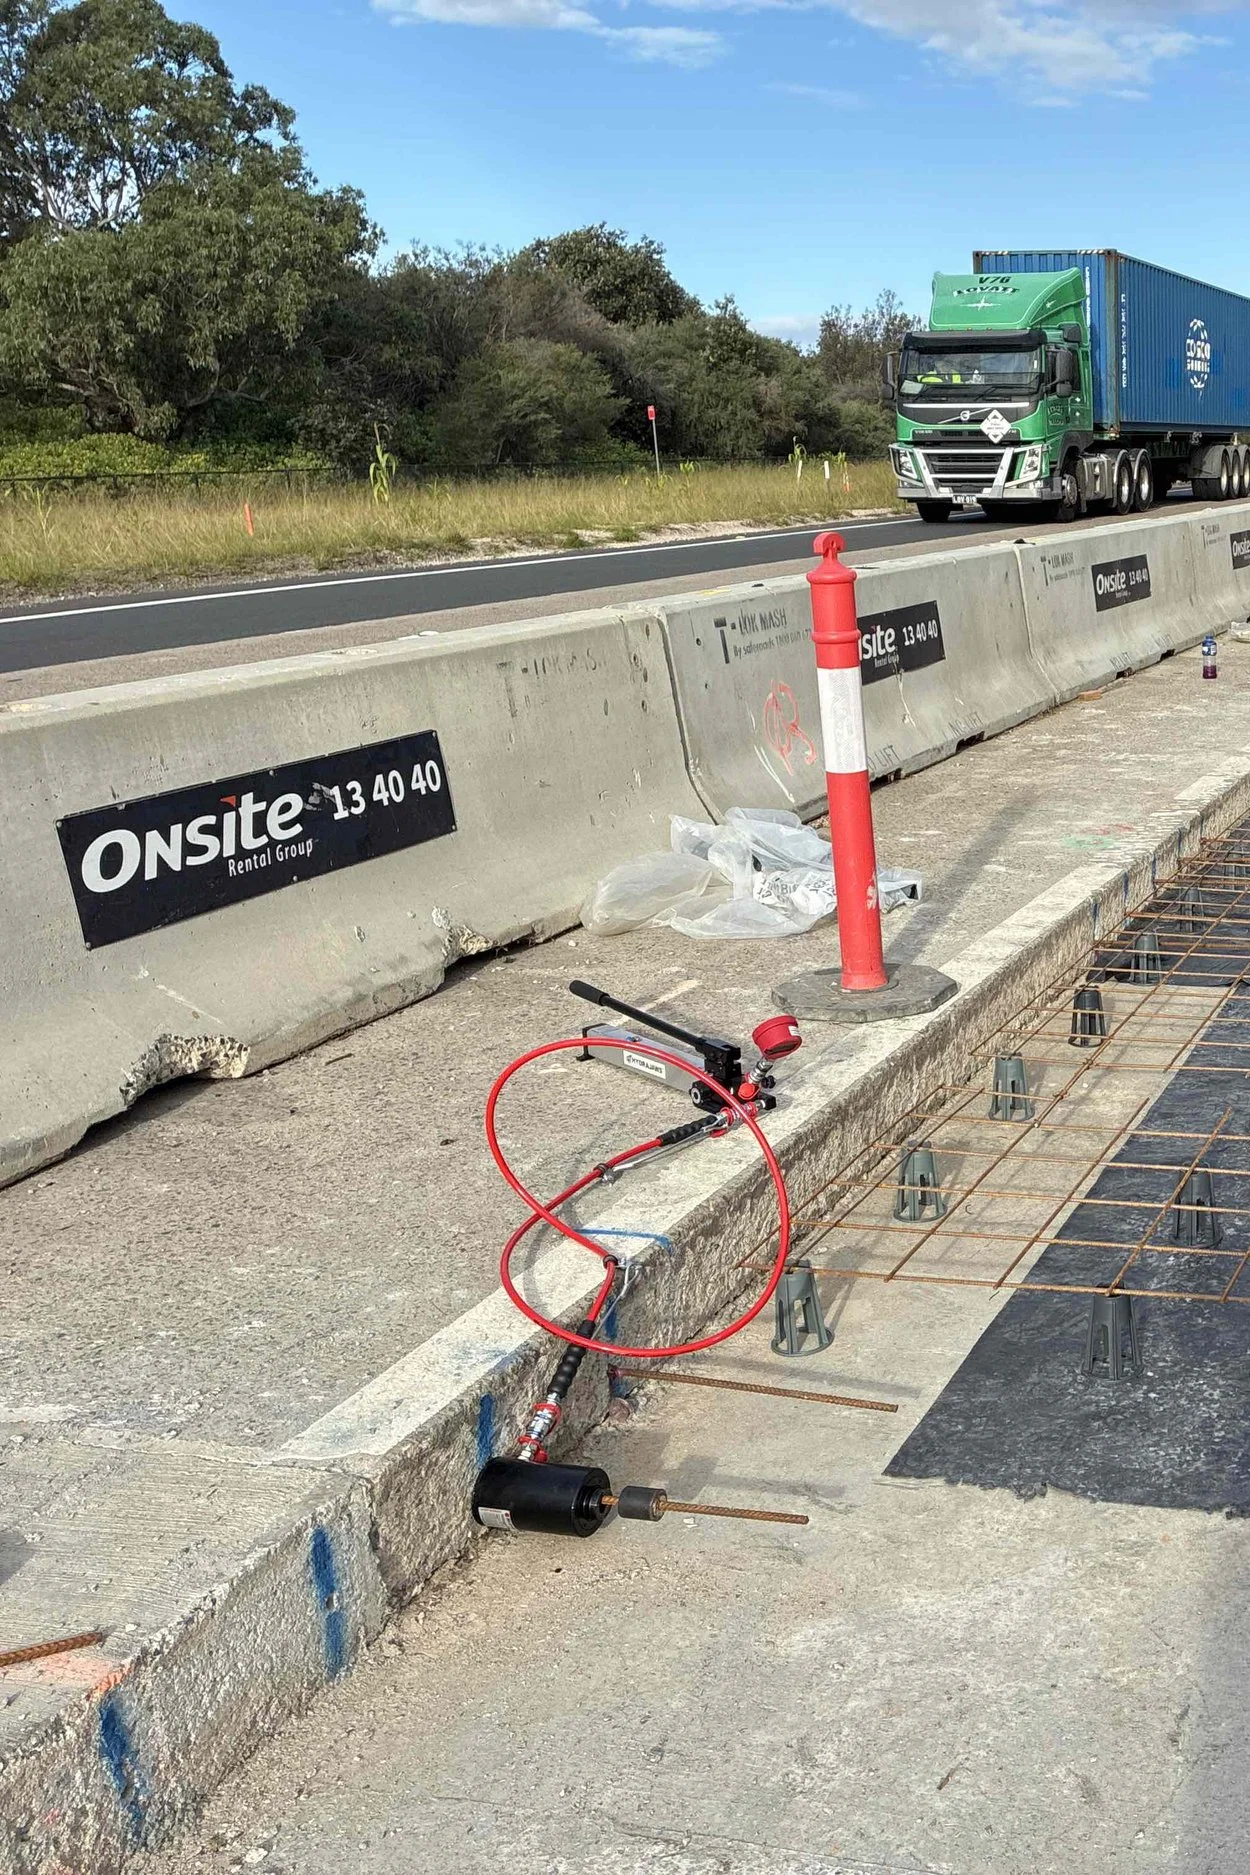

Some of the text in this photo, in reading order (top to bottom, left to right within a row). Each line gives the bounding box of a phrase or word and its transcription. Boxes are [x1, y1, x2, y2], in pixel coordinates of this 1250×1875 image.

[1096, 569, 1127, 595] Onsite
[759, 607, 788, 632] MASH
[859, 619, 938, 660] site 13 40 40
[875, 745, 901, 767] LIFT
[81, 759, 442, 893] Onsite 13 40 40
[229, 838, 314, 878] Rental Group
